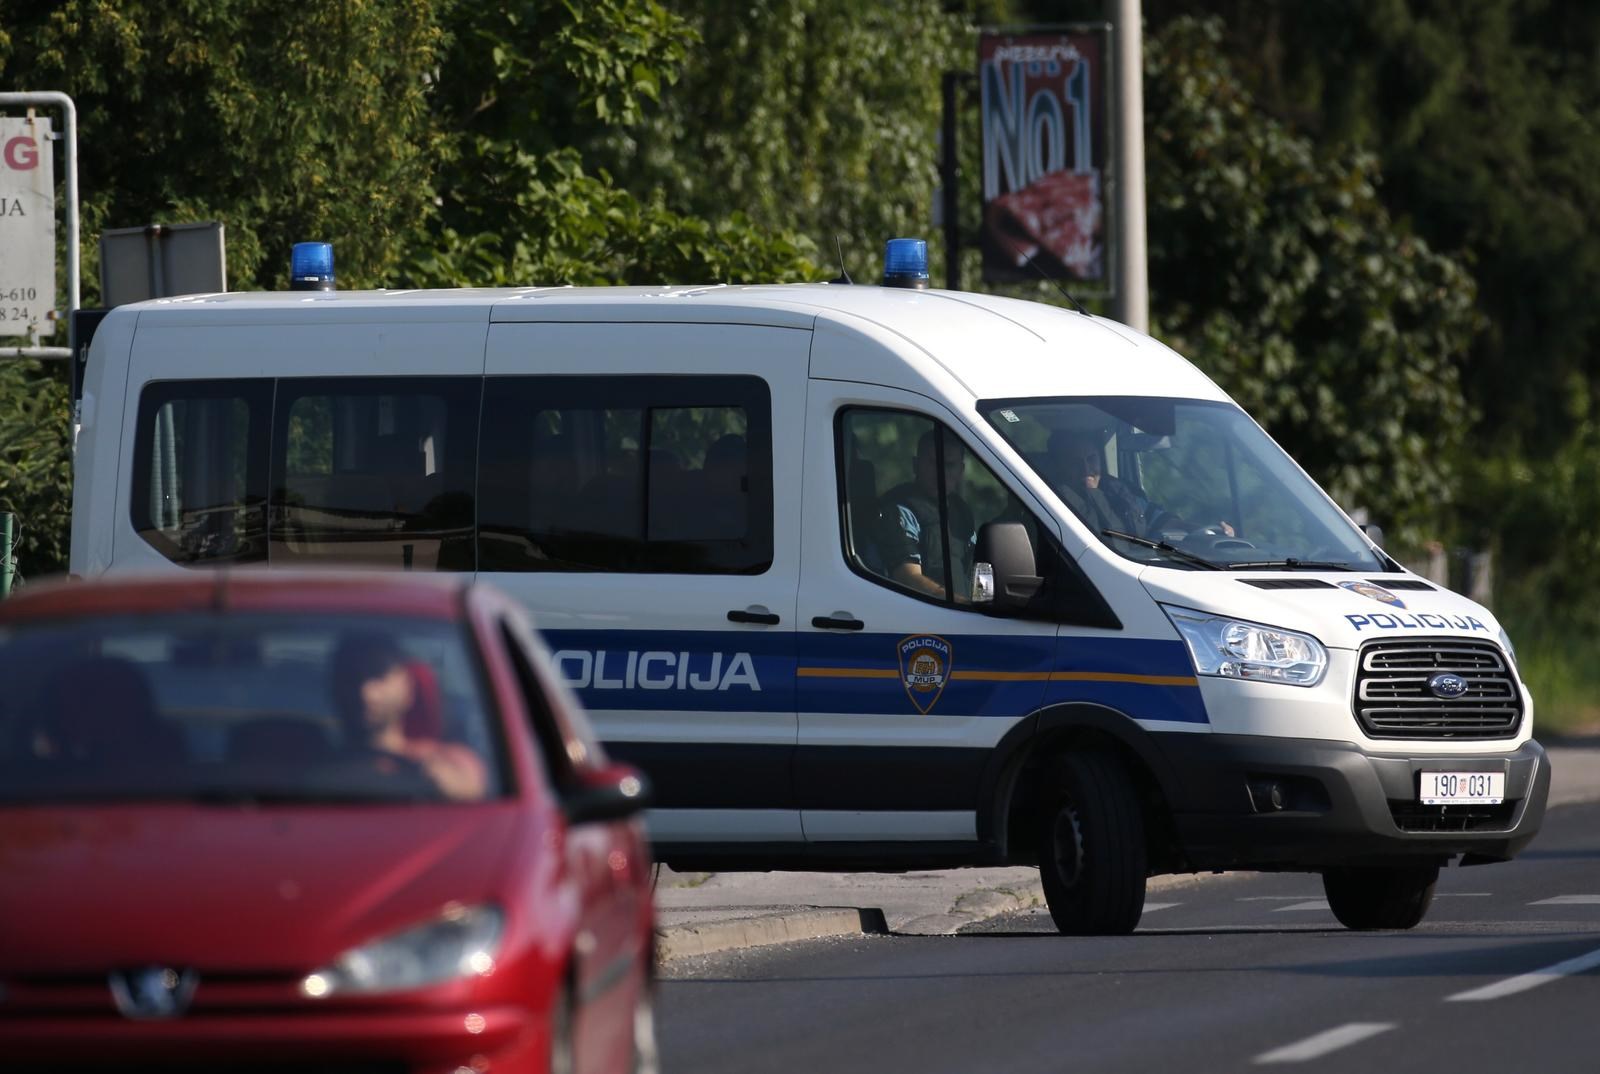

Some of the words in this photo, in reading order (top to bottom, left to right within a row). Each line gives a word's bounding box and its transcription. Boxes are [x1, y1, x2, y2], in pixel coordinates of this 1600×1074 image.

[4, 136, 39, 171] G
[1344, 614, 1490, 632] POLICIJA
[902, 639, 948, 654] POLICIJA
[552, 650, 762, 691] OLICIJA
[1435, 775, 1457, 796] 190
[1469, 775, 1491, 796] 031
